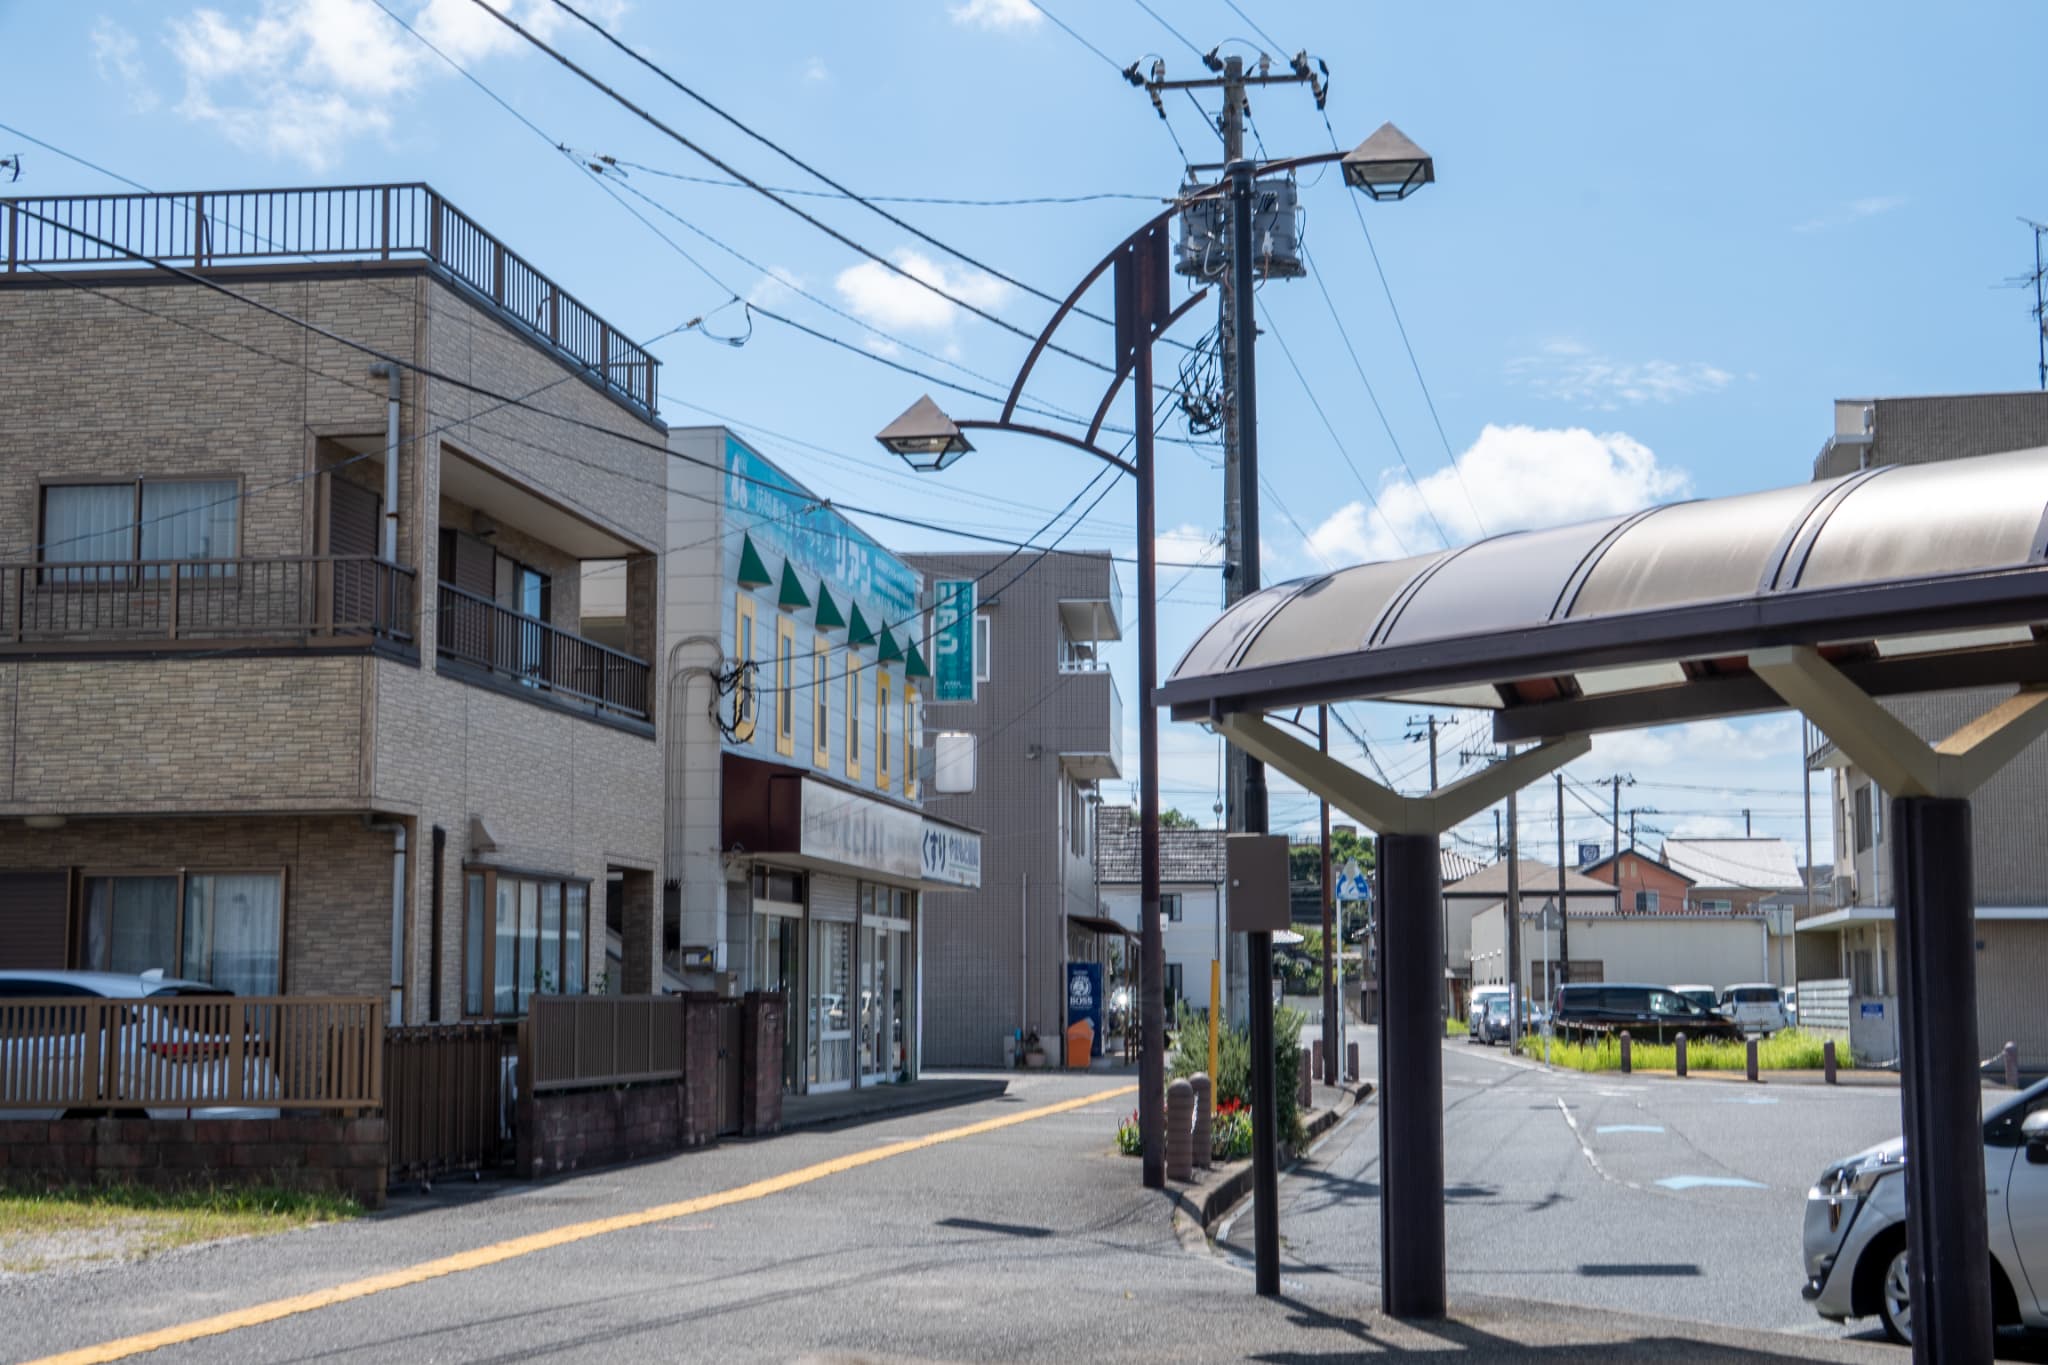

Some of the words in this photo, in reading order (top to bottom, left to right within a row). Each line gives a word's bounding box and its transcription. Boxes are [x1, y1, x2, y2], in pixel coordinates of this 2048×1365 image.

[836, 531, 871, 597] リアン
[939, 583, 958, 654] リアン
[922, 829, 946, 873] くすり
